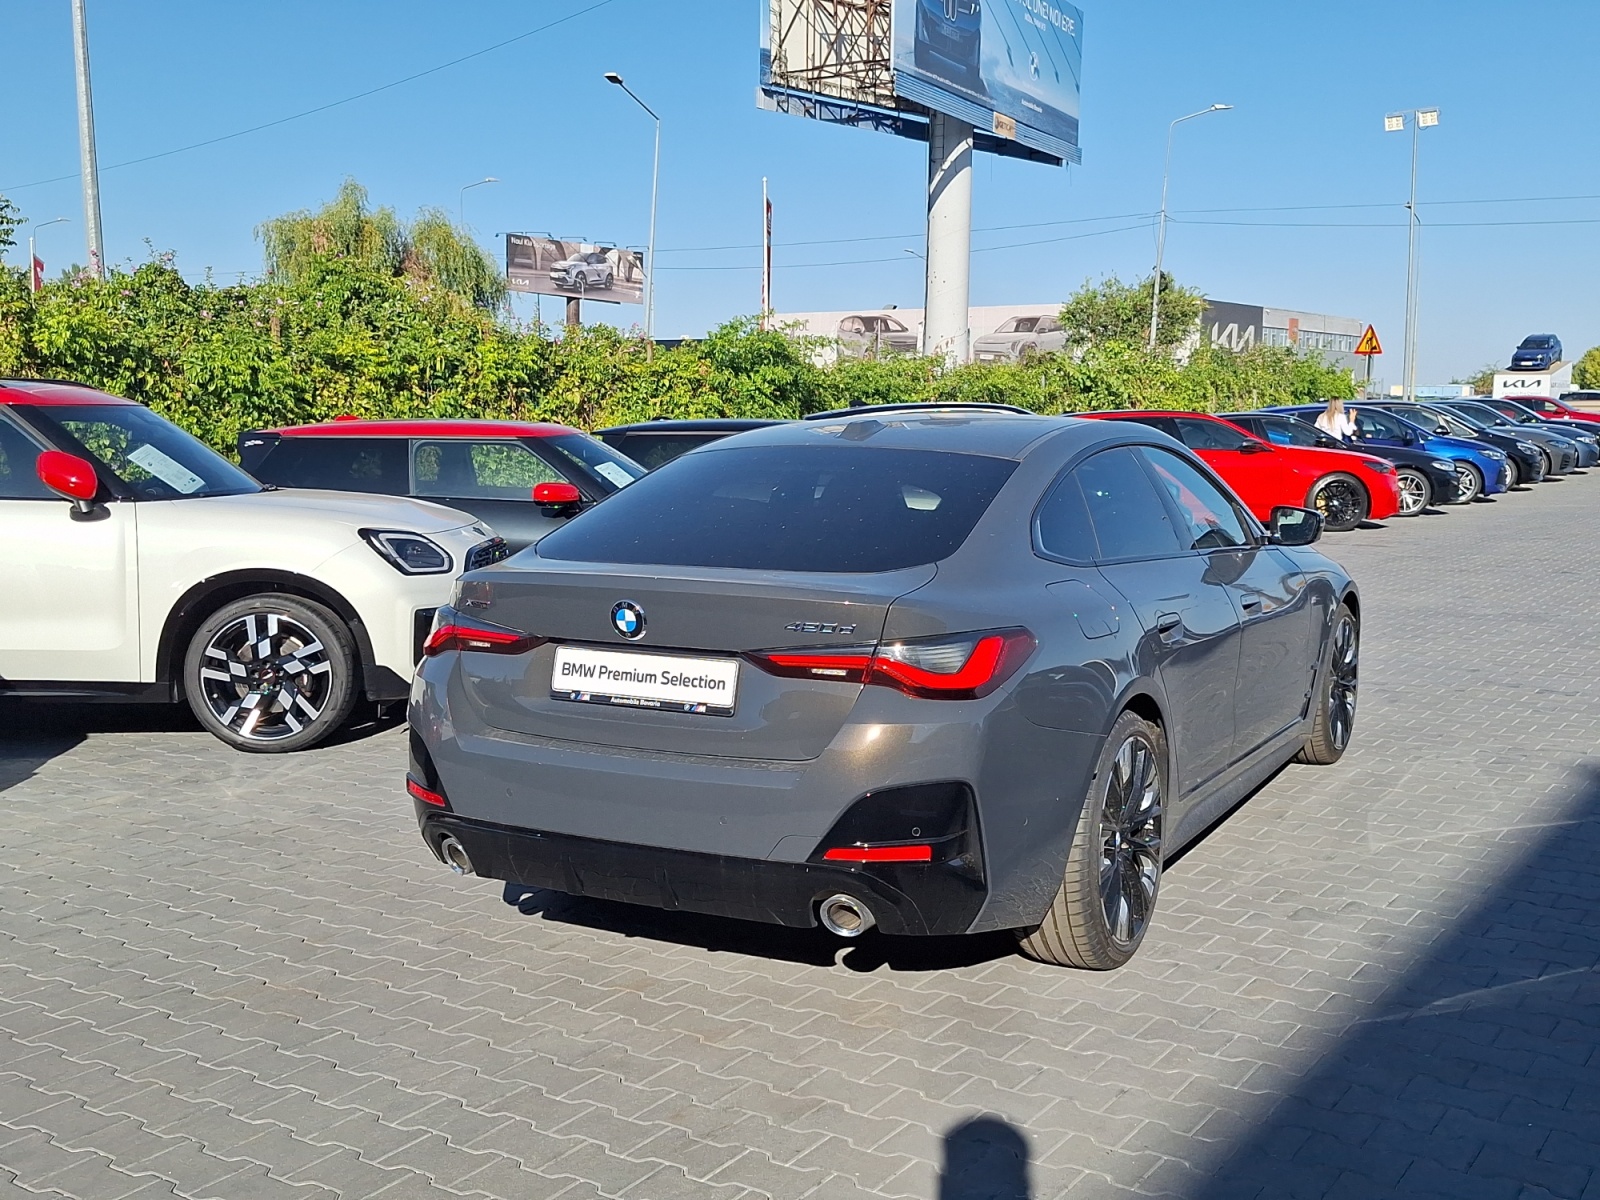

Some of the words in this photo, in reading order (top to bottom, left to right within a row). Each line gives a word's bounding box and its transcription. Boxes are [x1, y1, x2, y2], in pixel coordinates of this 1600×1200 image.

[1503, 379, 1541, 388] KIA
[561, 662, 596, 678] BMW
[598, 665, 657, 684] Premium
[660, 671, 726, 690] Selection
